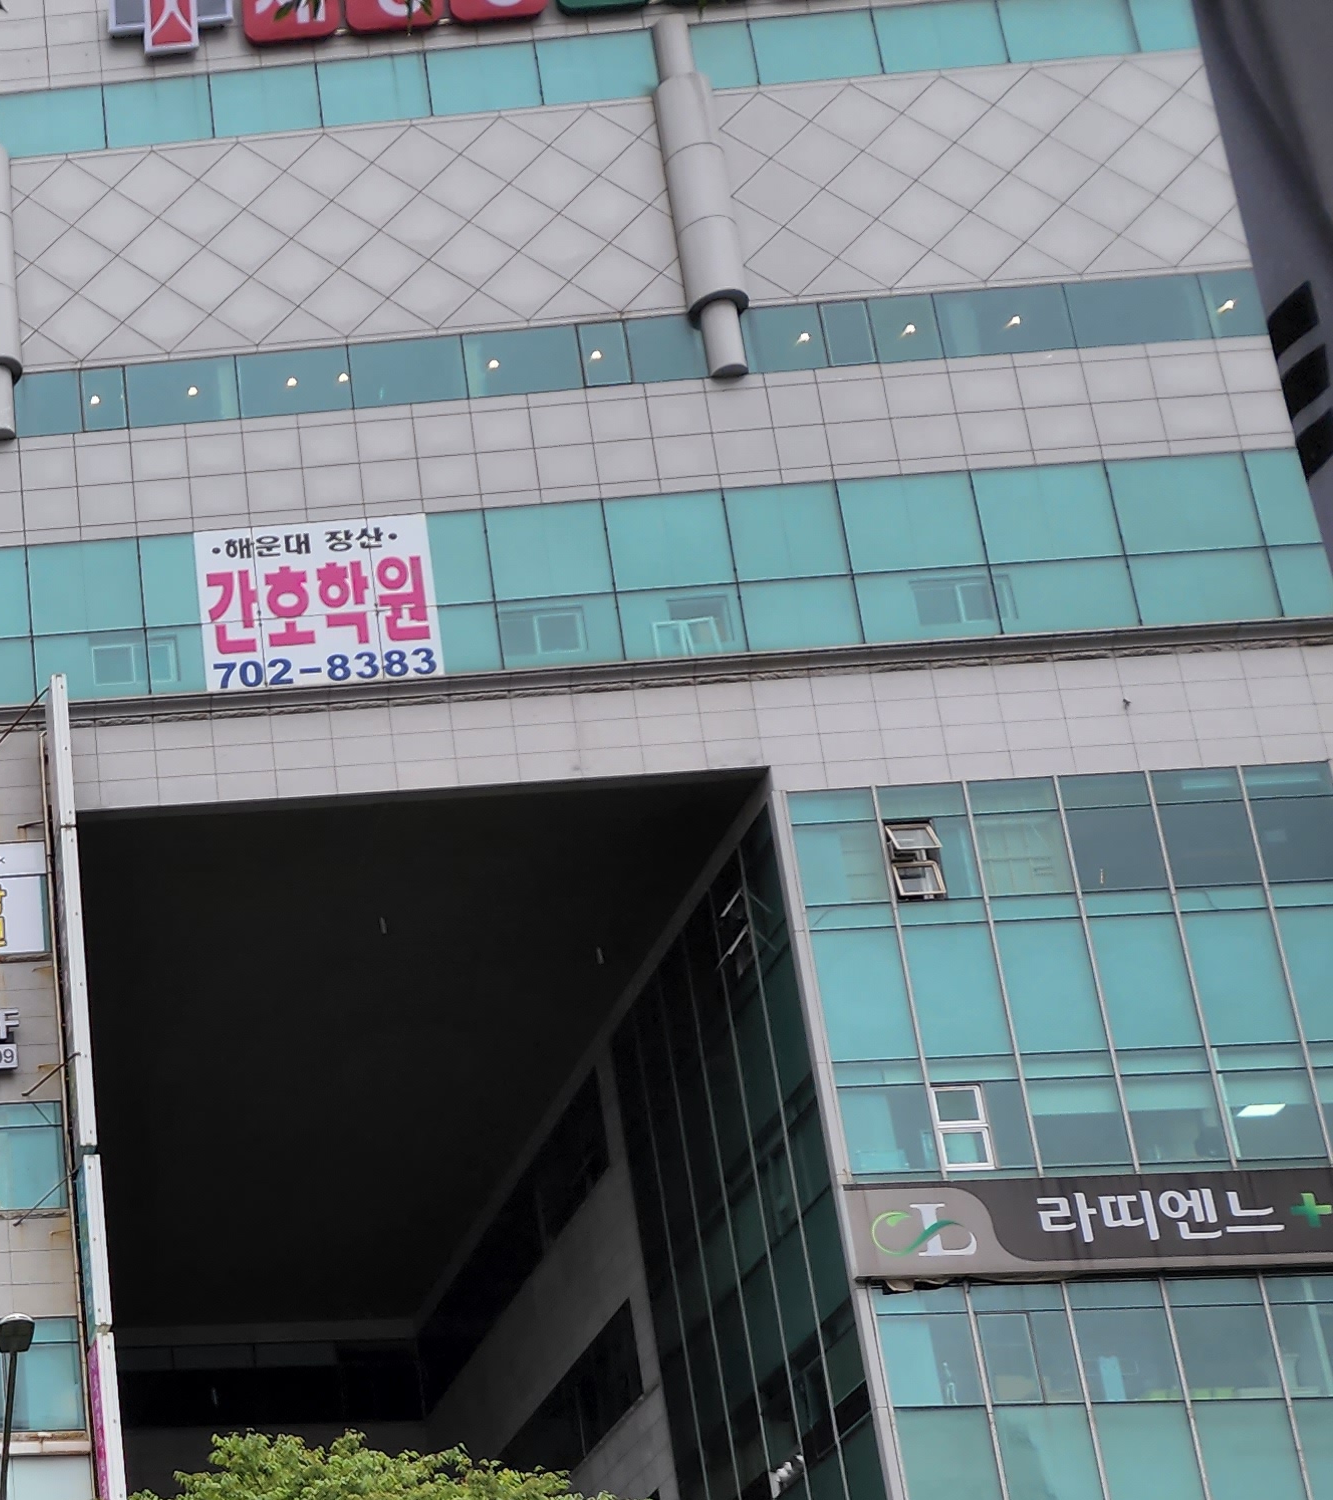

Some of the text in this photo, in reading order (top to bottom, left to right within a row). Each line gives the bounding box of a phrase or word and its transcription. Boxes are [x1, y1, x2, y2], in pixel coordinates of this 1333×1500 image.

[206, 555, 431, 655] 간호학원
[213, 648, 437, 689] 702-8383
[1036, 1187, 1286, 1247] 라띠엔느
